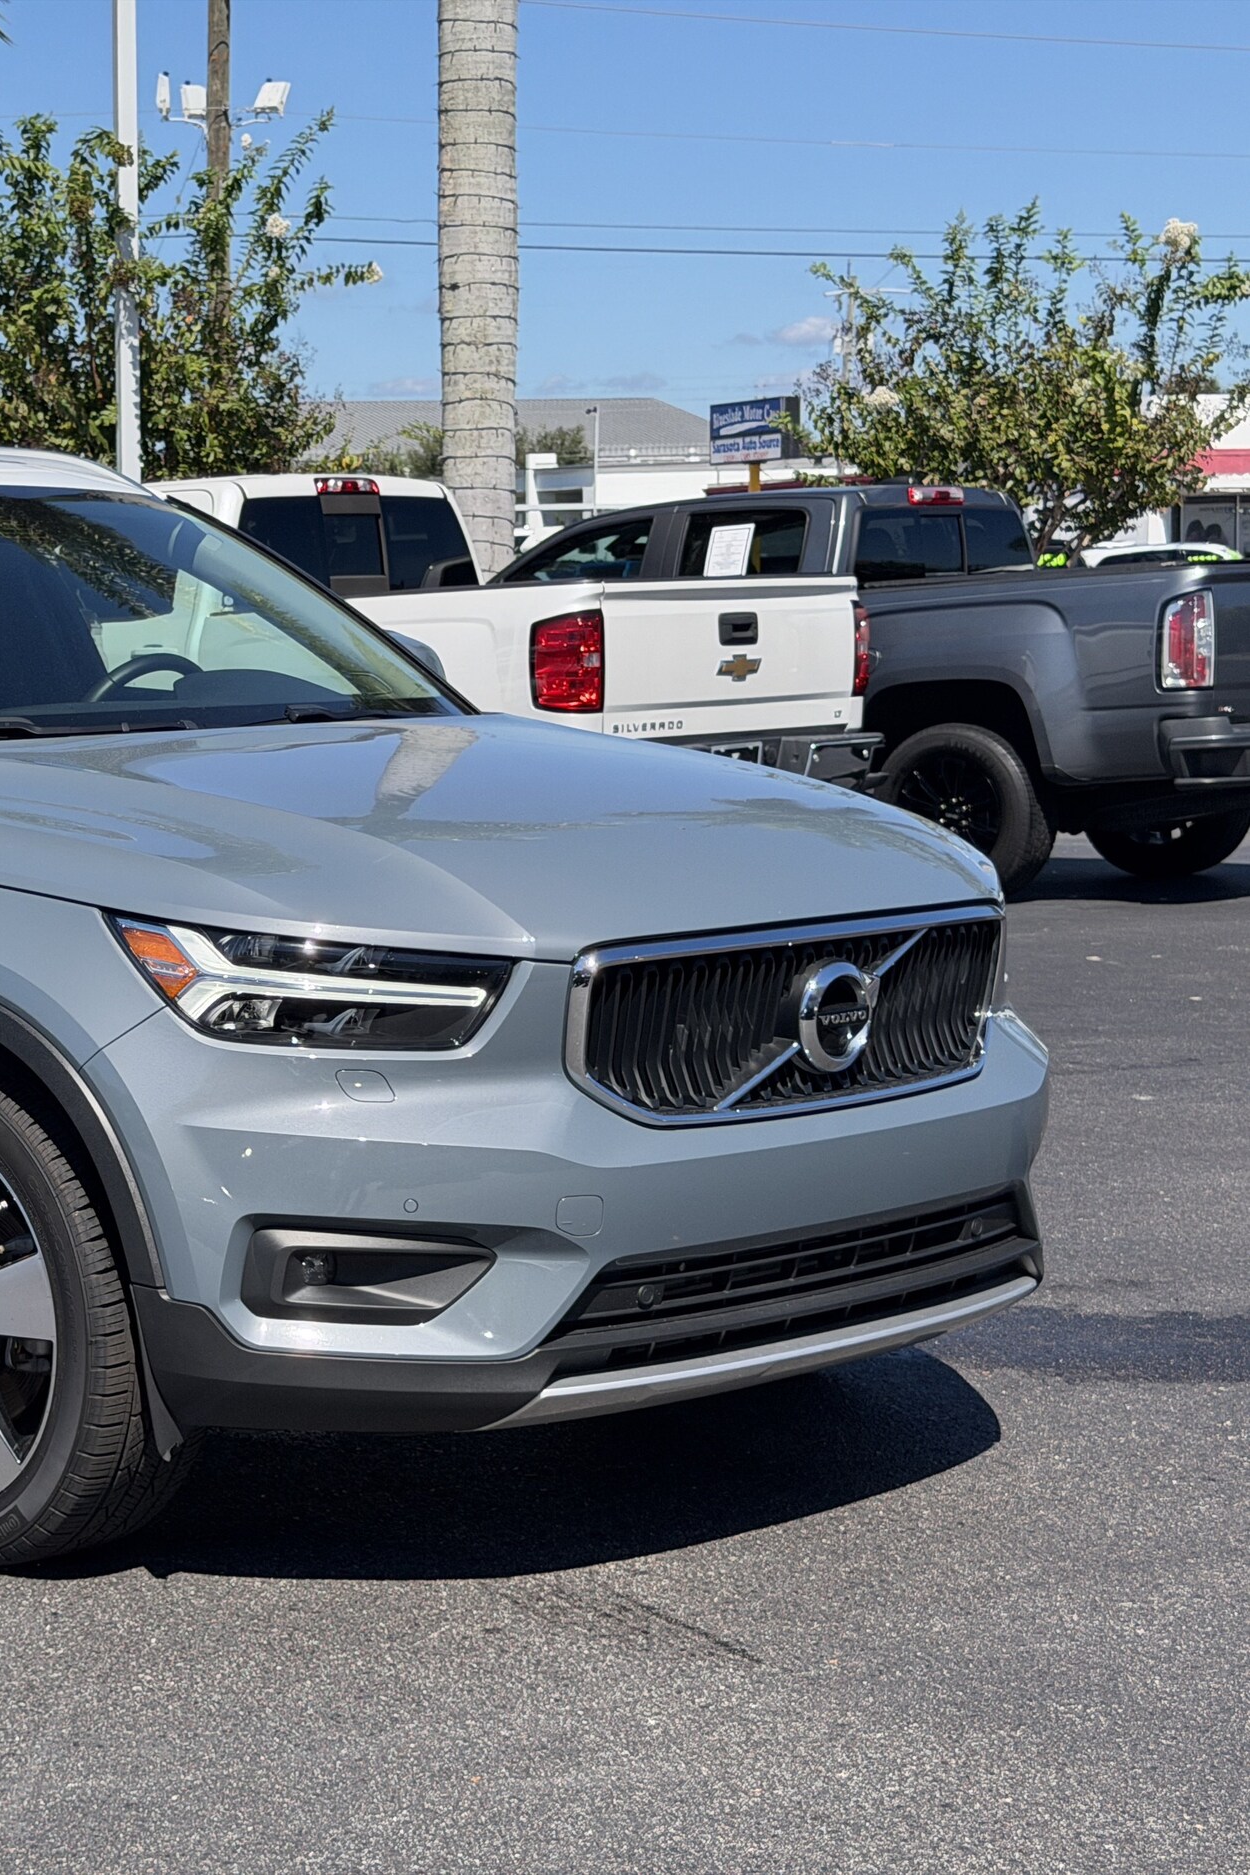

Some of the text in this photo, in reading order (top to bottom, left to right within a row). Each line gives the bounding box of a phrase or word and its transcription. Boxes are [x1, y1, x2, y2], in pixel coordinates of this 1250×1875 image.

[712, 436, 780, 454] Sarasota Auto Source
[612, 720, 684, 734] SILVERADO
[818, 1009, 867, 1026] VOLVO
